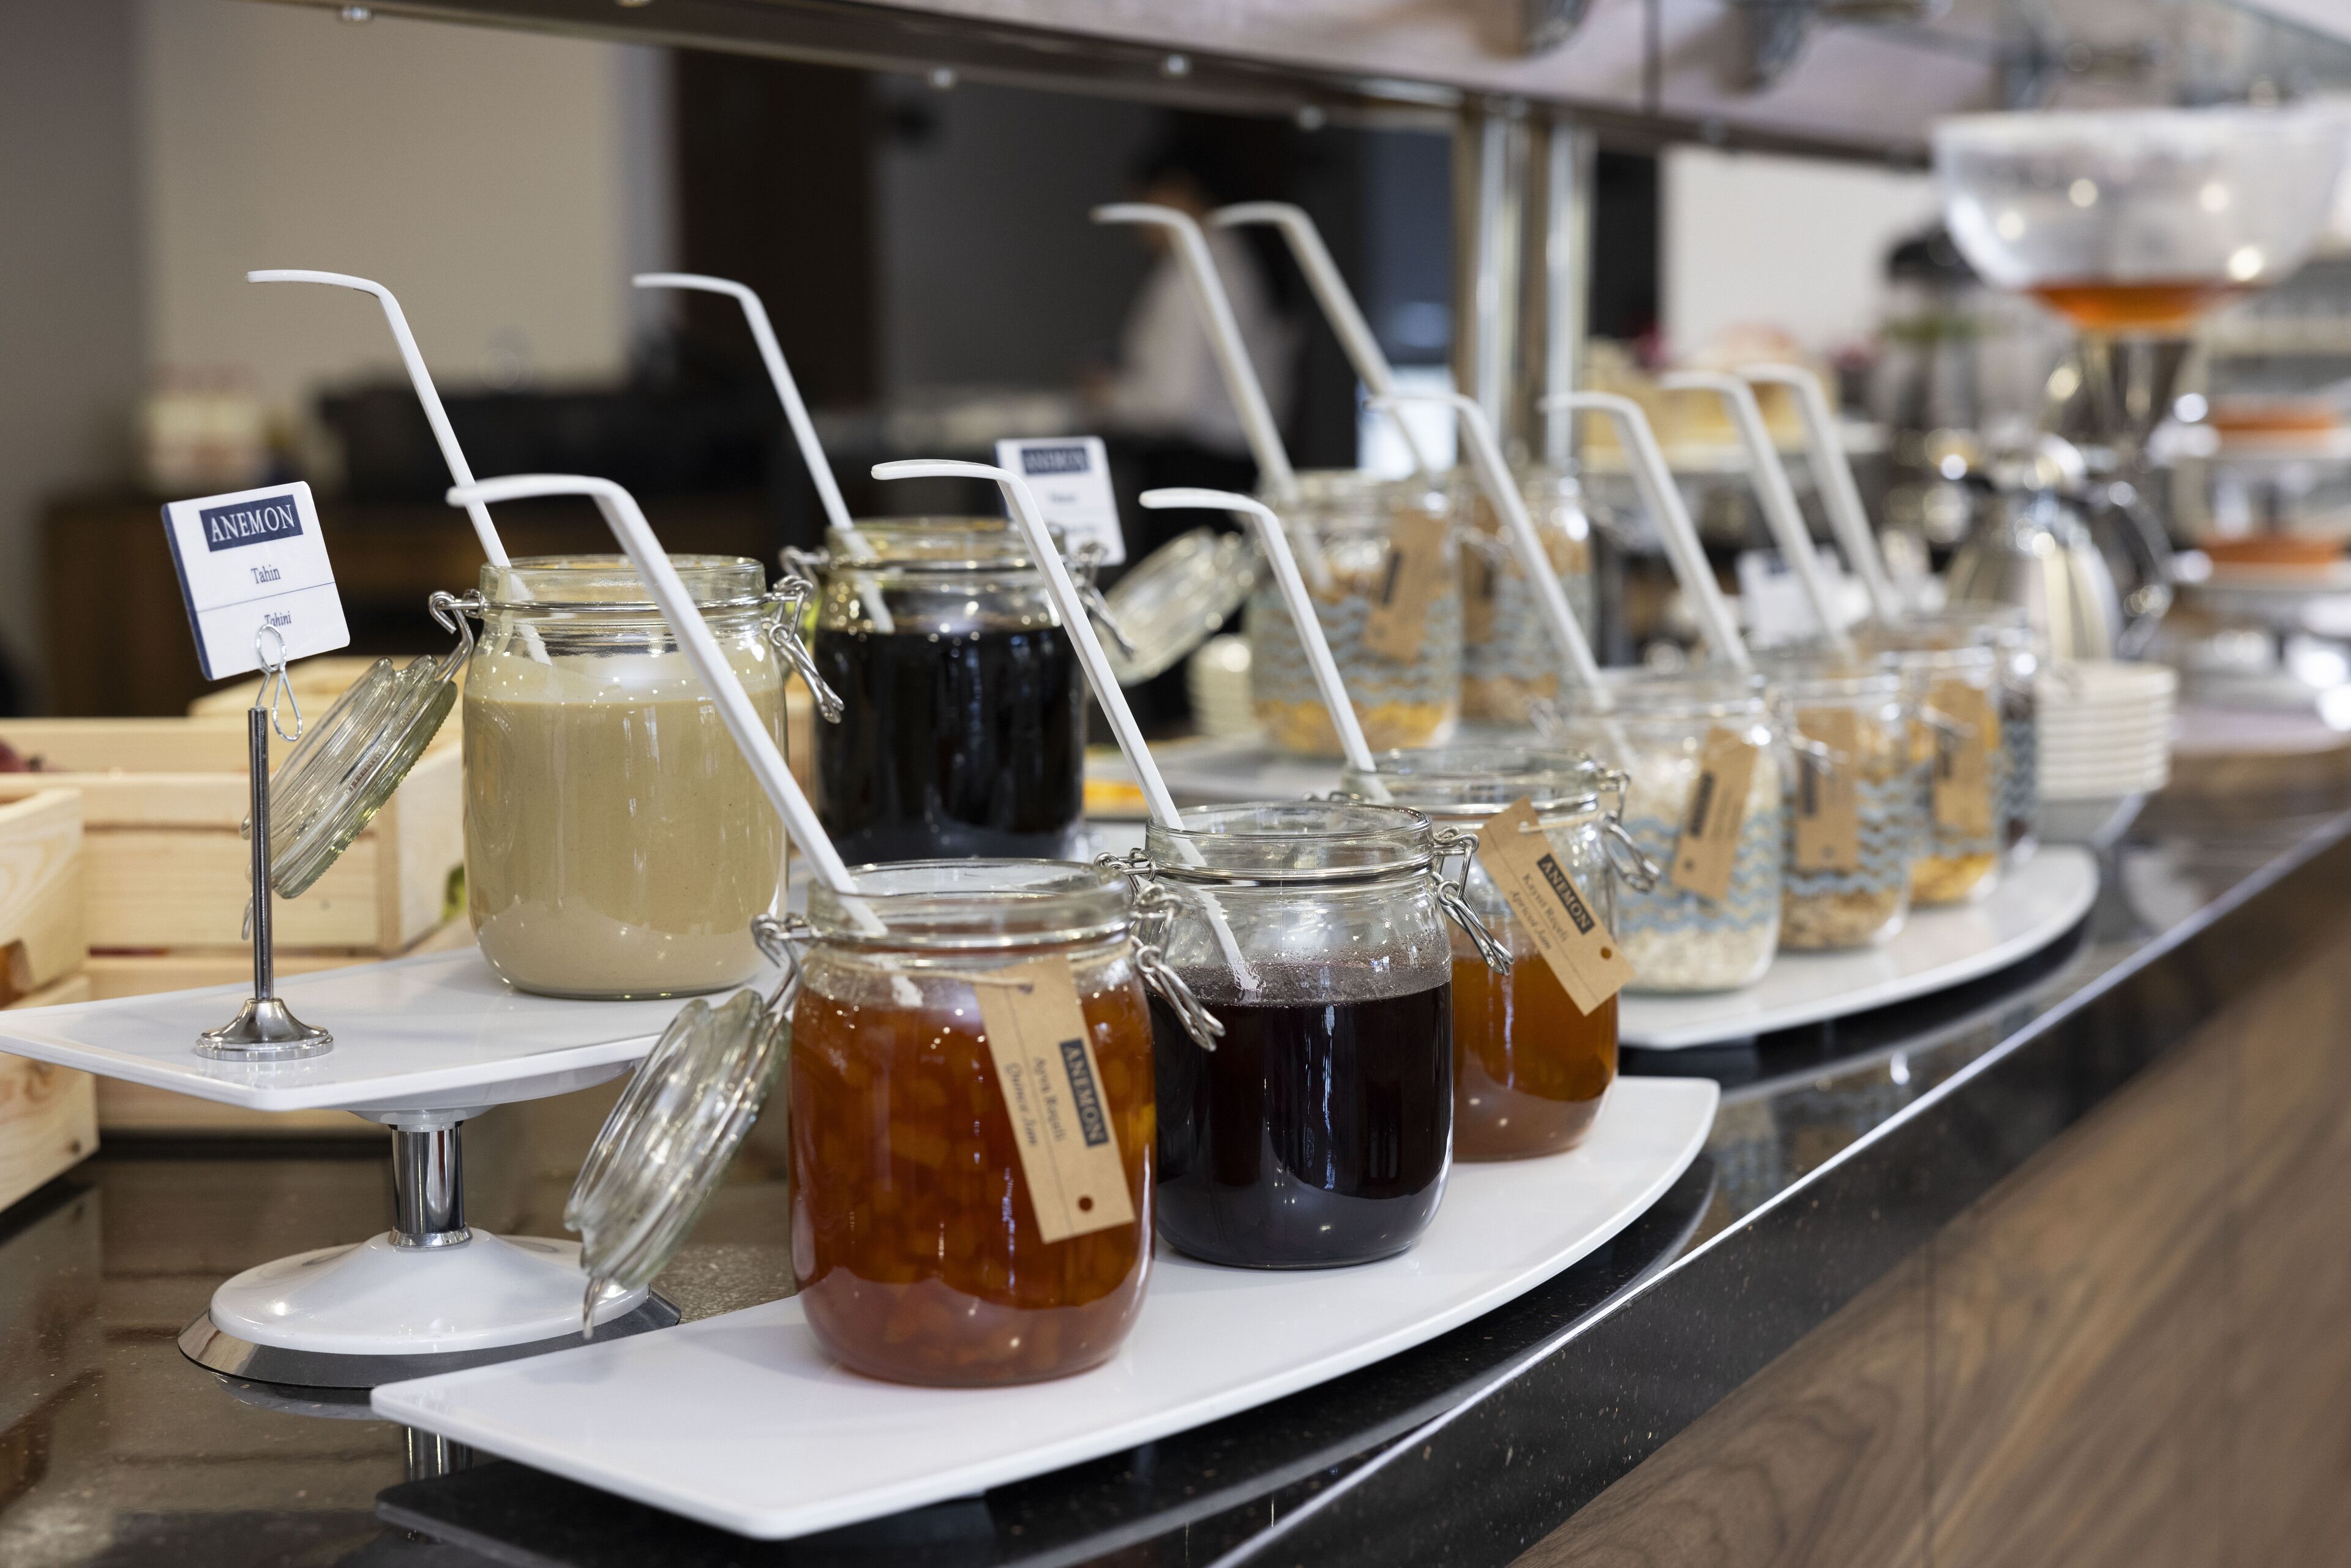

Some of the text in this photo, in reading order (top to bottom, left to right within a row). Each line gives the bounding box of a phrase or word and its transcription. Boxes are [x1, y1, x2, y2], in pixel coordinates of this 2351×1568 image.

[212, 504, 295, 542] ANEMON
[250, 565, 281, 584] Tahin
[264, 611, 292, 627] Tahini
[1543, 861, 1591, 929] ANEMON
[1065, 1046, 1104, 1141] ANEMON
